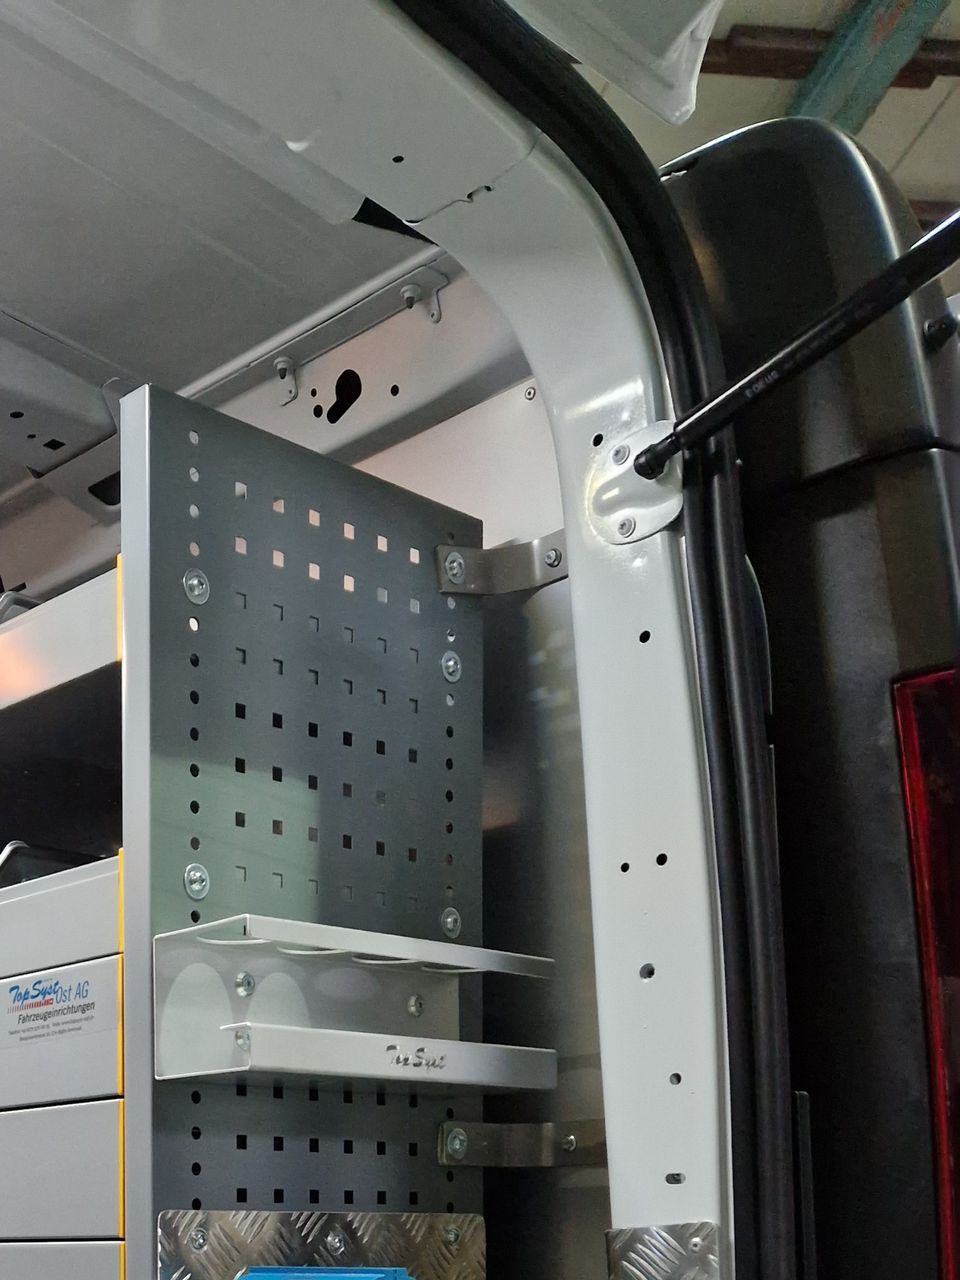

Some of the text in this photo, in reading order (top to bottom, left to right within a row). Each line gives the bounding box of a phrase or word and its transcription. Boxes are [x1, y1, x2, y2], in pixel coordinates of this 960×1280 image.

[55, 985, 72, 1004] Ost
[74, 980, 89, 1000] AG
[17, 1001, 96, 1025] Fahrzeugeinrichtungen
